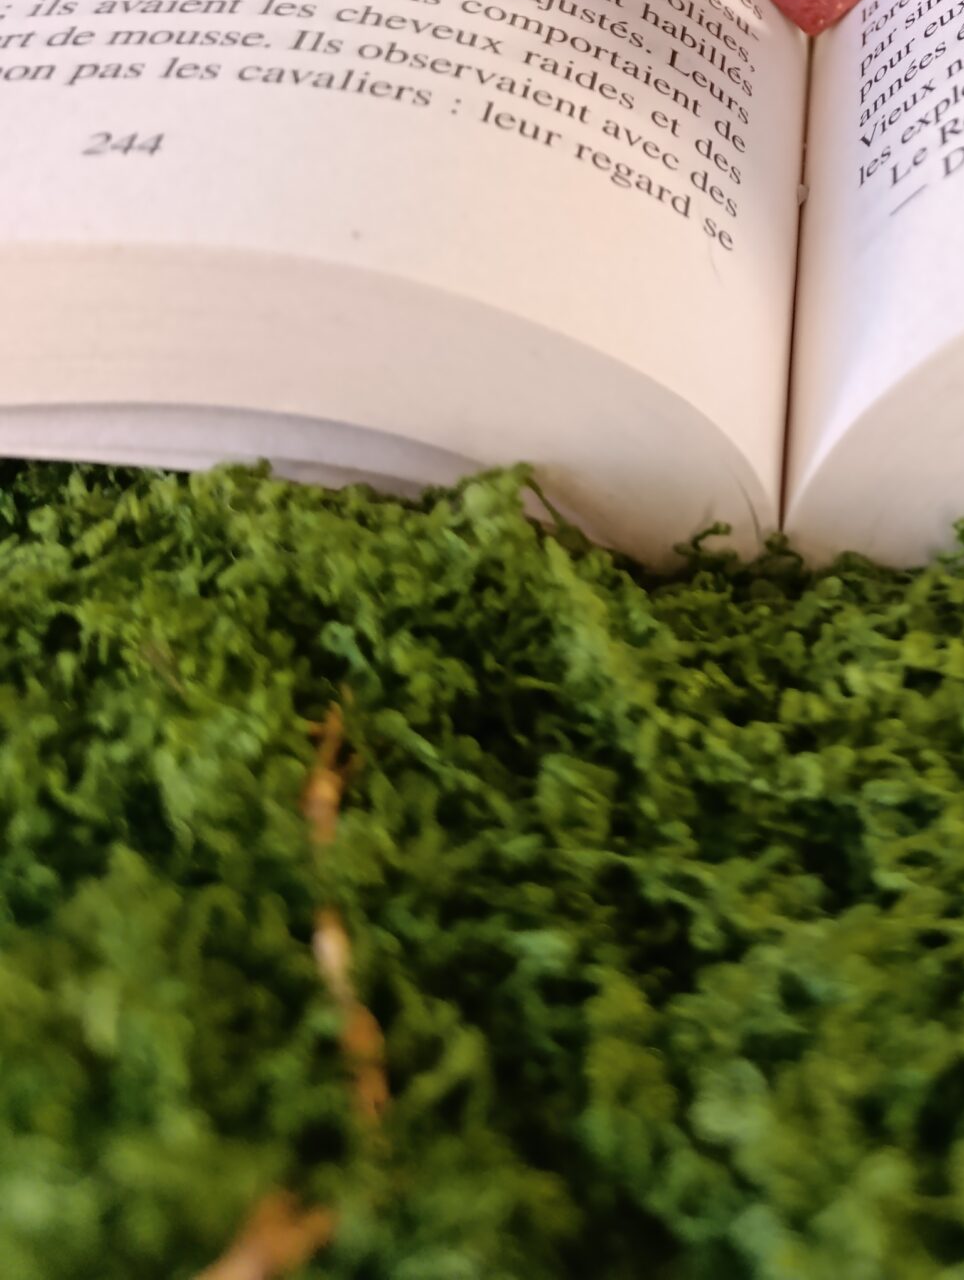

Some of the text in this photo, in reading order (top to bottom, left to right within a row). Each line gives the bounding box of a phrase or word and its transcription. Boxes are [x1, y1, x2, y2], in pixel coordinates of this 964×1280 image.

[640, 2, 753, 98] habillés
[665, 47, 749, 125] Leurs
[858, 40, 948, 129] années
[859, 37, 916, 107] pour
[860, 27, 898, 78] par
[46, 25, 738, 218] de mousse. Ils observaient avec des
[335, 4, 503, 56] cheveux
[522, 50, 635, 111] raides
[650, 109, 681, 138] et
[693, 138, 741, 185] des
[859, 77, 937, 149] Vieux
[63, 56, 734, 252] pas les cavaliers leur regard se
[81, 130, 165, 157] 244
[713, 119, 746, 154] de
[858, 145, 893, 188] les
[890, 146, 928, 187] Le
